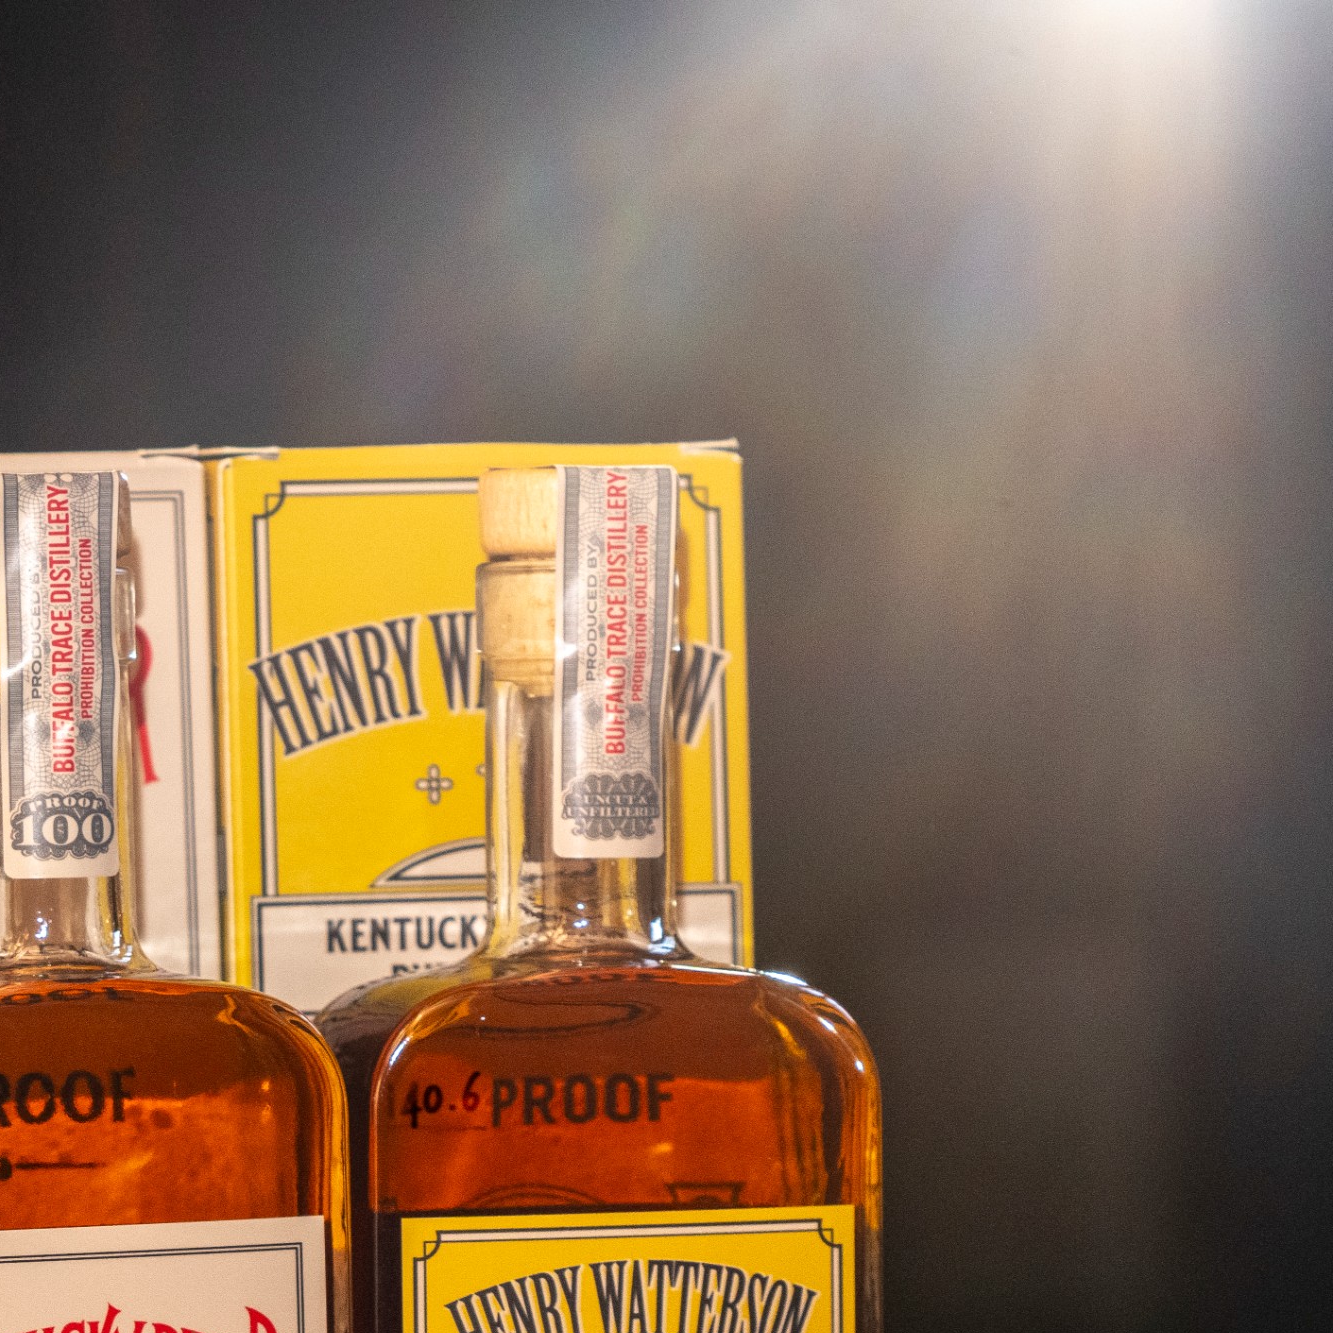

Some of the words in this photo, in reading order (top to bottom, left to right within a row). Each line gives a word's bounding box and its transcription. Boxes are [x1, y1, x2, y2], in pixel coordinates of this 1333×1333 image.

[48, 486, 71, 602] DISTILLERY
[606, 471, 628, 589] DISTILLERY
[637, 525, 648, 610] COLLECTION
[80, 539, 92, 629] COLLECTION
[586, 576, 596, 681] PRODUCED
[606, 594, 627, 662] TRACE
[50, 609, 73, 677] TRACE
[81, 634, 93, 719] PROHIBITION
[247, 616, 423, 757] HENRY
[632, 612, 647, 702] PROHIBITION
[52, 680, 74, 772] BUFFALO
[605, 665, 625, 754] BUFFALO
[18, 813, 112, 846] 100
[492, 1072, 675, 1128] PROOF
